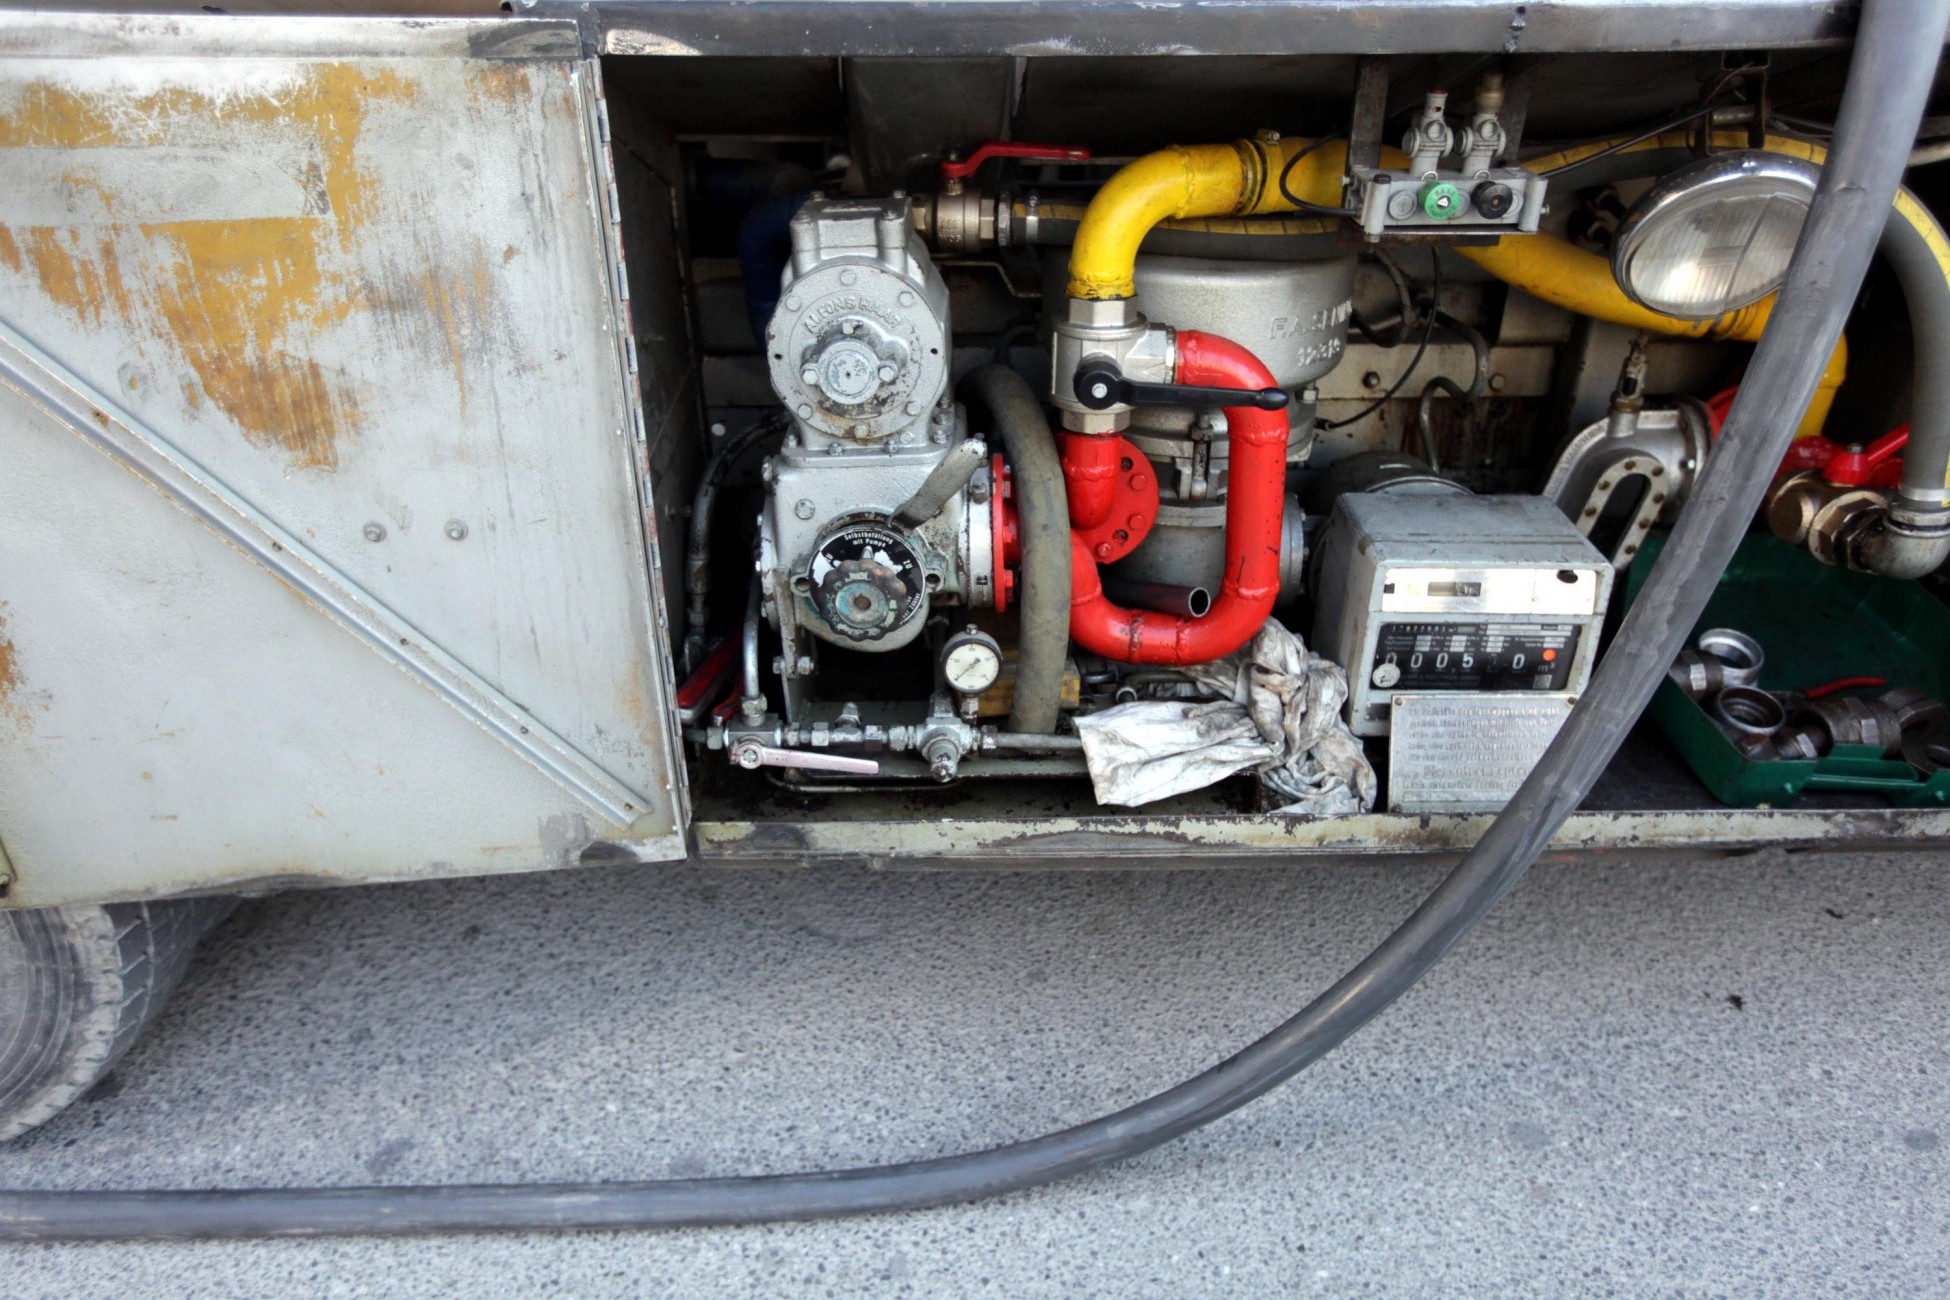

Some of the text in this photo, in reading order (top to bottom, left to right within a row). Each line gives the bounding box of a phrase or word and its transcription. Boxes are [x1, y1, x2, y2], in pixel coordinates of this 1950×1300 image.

[803, 295, 902, 334] ALFONS HAAR
[844, 531, 894, 545] Selbstbefüllung
[865, 538, 887, 548] Pumpe
